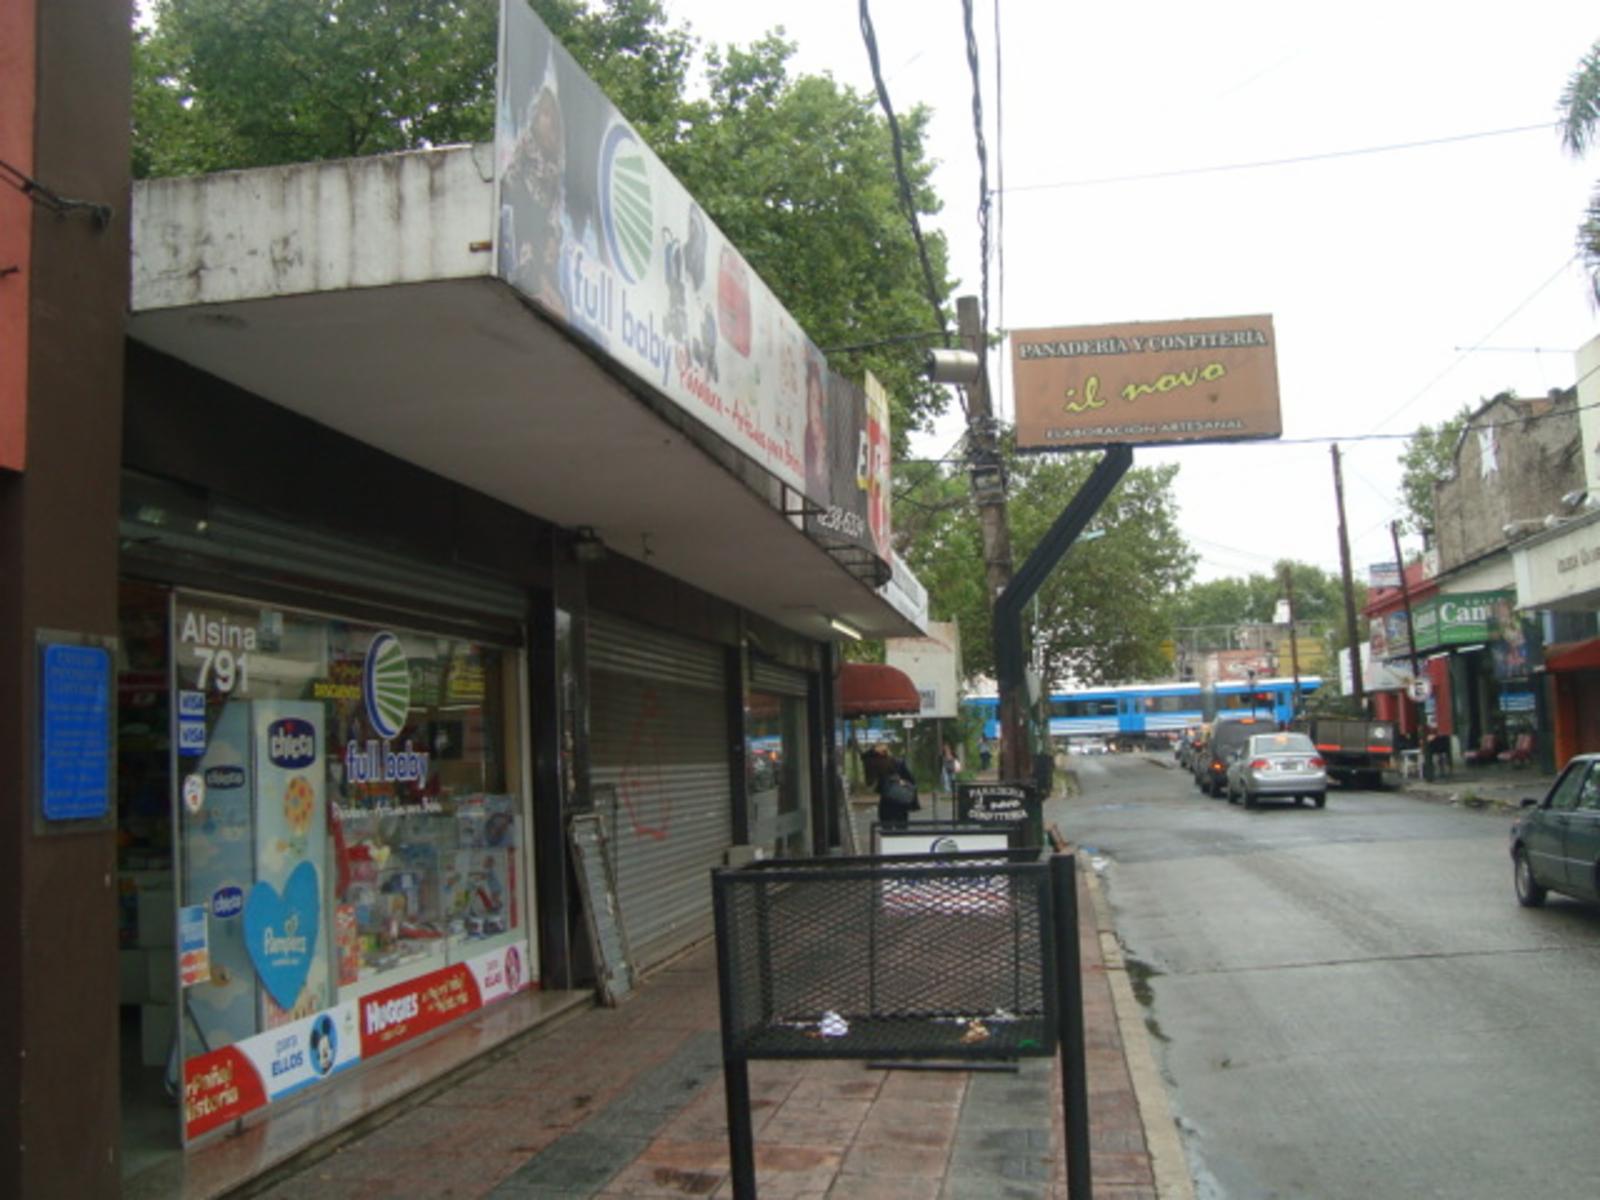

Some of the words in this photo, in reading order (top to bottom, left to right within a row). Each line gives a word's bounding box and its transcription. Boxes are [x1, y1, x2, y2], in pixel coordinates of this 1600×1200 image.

[570, 245, 613, 332] full
[621, 290, 672, 387] baby
[1129, 337, 1145, 351] Y
[1065, 376, 1106, 412] il
[1121, 361, 1226, 401] novo
[181, 611, 257, 650] Alsina
[194, 648, 250, 692] 791
[346, 740, 380, 783] full
[383, 740, 429, 789] baby
